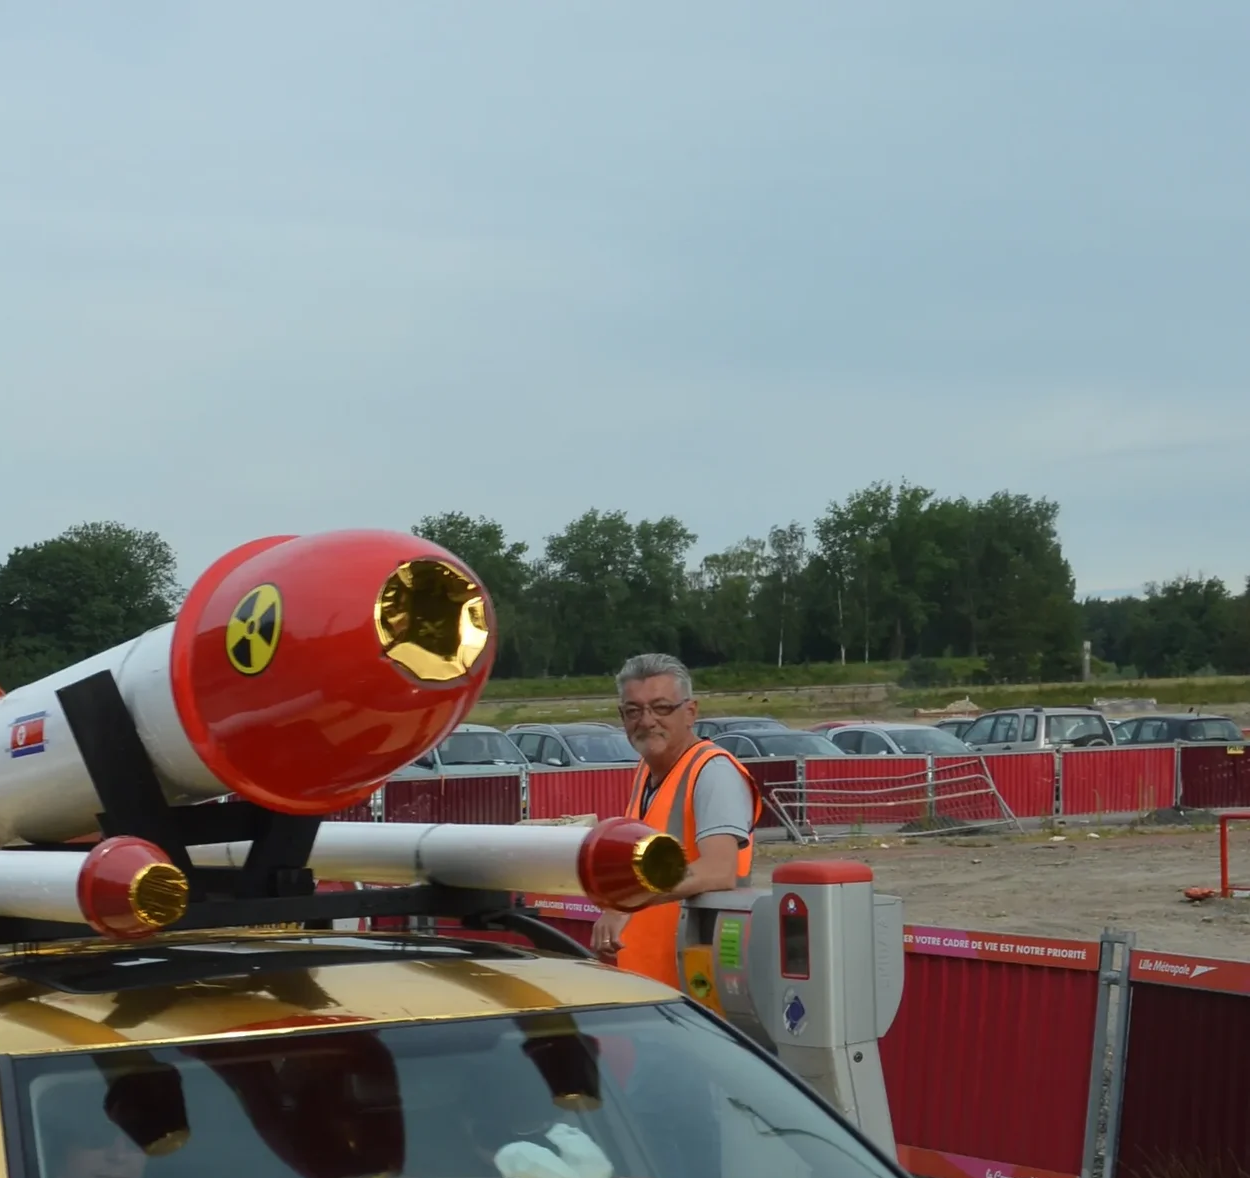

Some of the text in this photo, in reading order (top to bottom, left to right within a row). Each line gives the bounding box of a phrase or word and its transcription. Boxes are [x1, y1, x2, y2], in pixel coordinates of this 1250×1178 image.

[915, 935, 941, 946] VOTRE
[943, 937, 970, 949] CADRE
[971, 941, 982, 950] DE
[984, 942, 998, 951] VIE
[1000, 943, 1014, 953] EST
[1016, 945, 1046, 956] NOTRE
[1047, 948, 1087, 960] PRIORITÉ
[1153, 960, 1190, 976] Métropole
